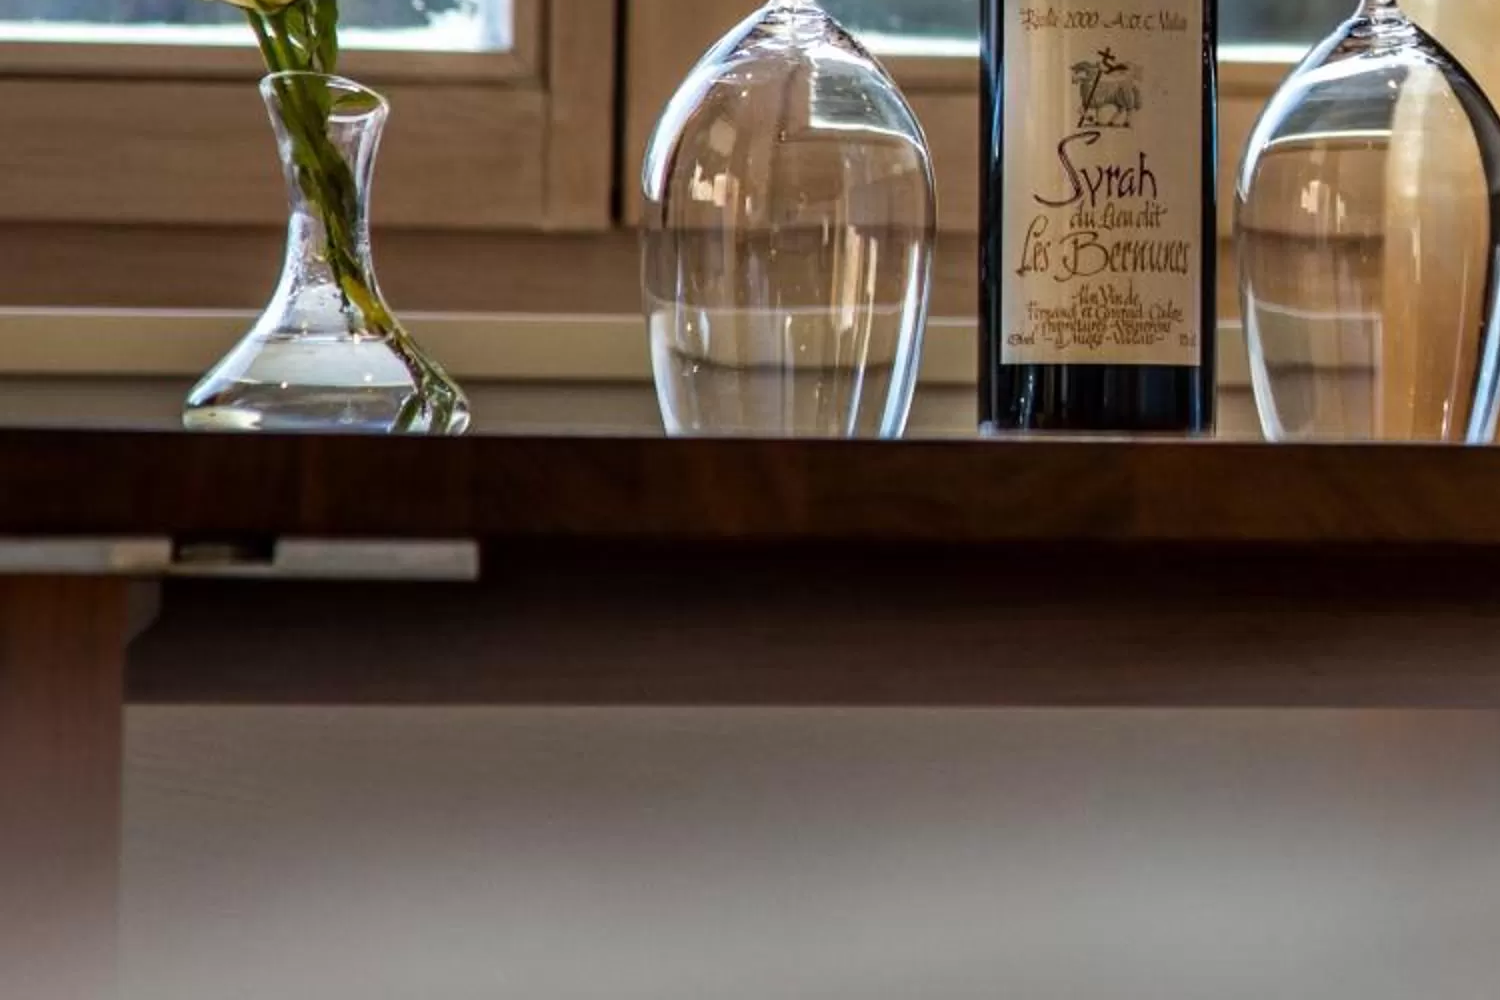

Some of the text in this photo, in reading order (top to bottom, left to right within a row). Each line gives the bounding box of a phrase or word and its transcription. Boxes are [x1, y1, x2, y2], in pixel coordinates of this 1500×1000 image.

[1034, 131, 1157, 207] Syrah
[1016, 214, 1051, 277] Les
[1069, 201, 1096, 229] du
